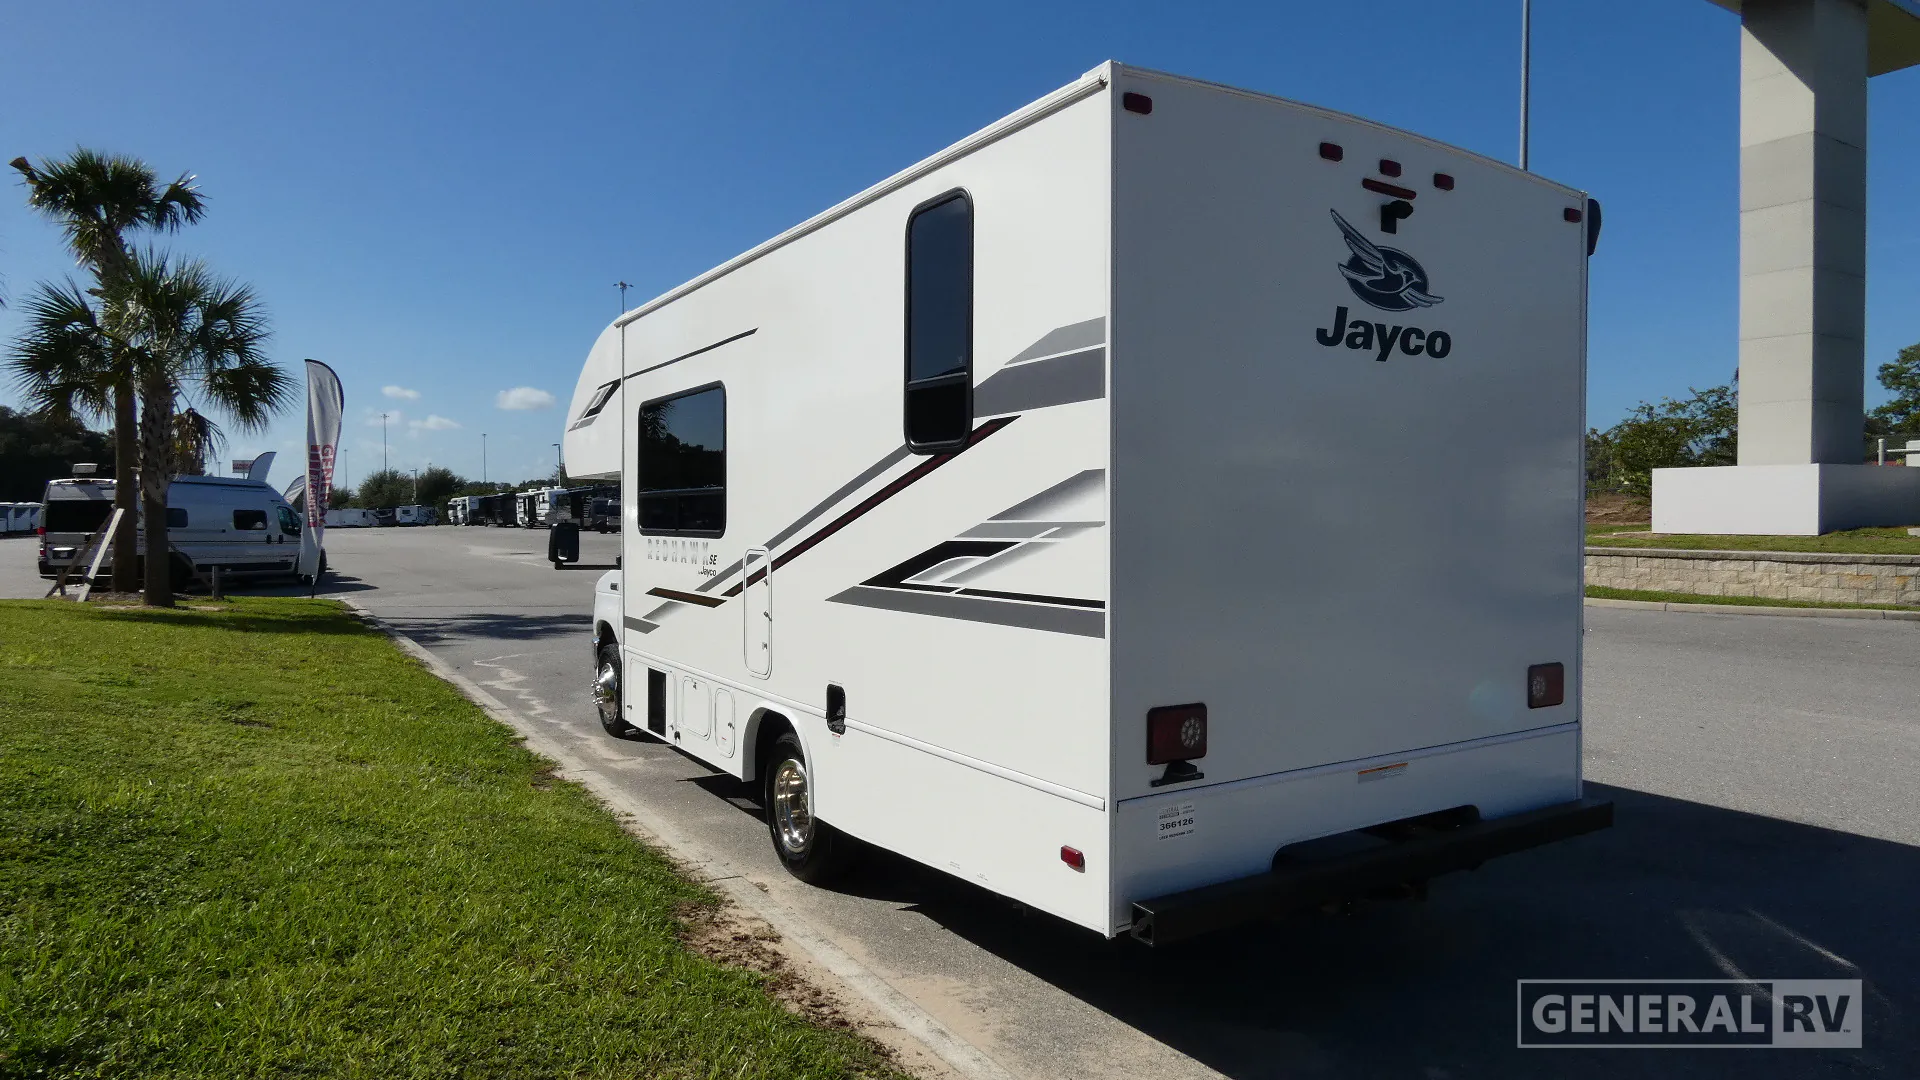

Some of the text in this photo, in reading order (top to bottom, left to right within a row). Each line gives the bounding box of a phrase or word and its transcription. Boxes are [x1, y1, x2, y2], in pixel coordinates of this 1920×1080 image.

[1316, 306, 1451, 362] Jayco
[647, 538, 718, 566] REDHAWK SE
[700, 565, 717, 578] Jayco
[1159, 817, 1194, 831] 366126
